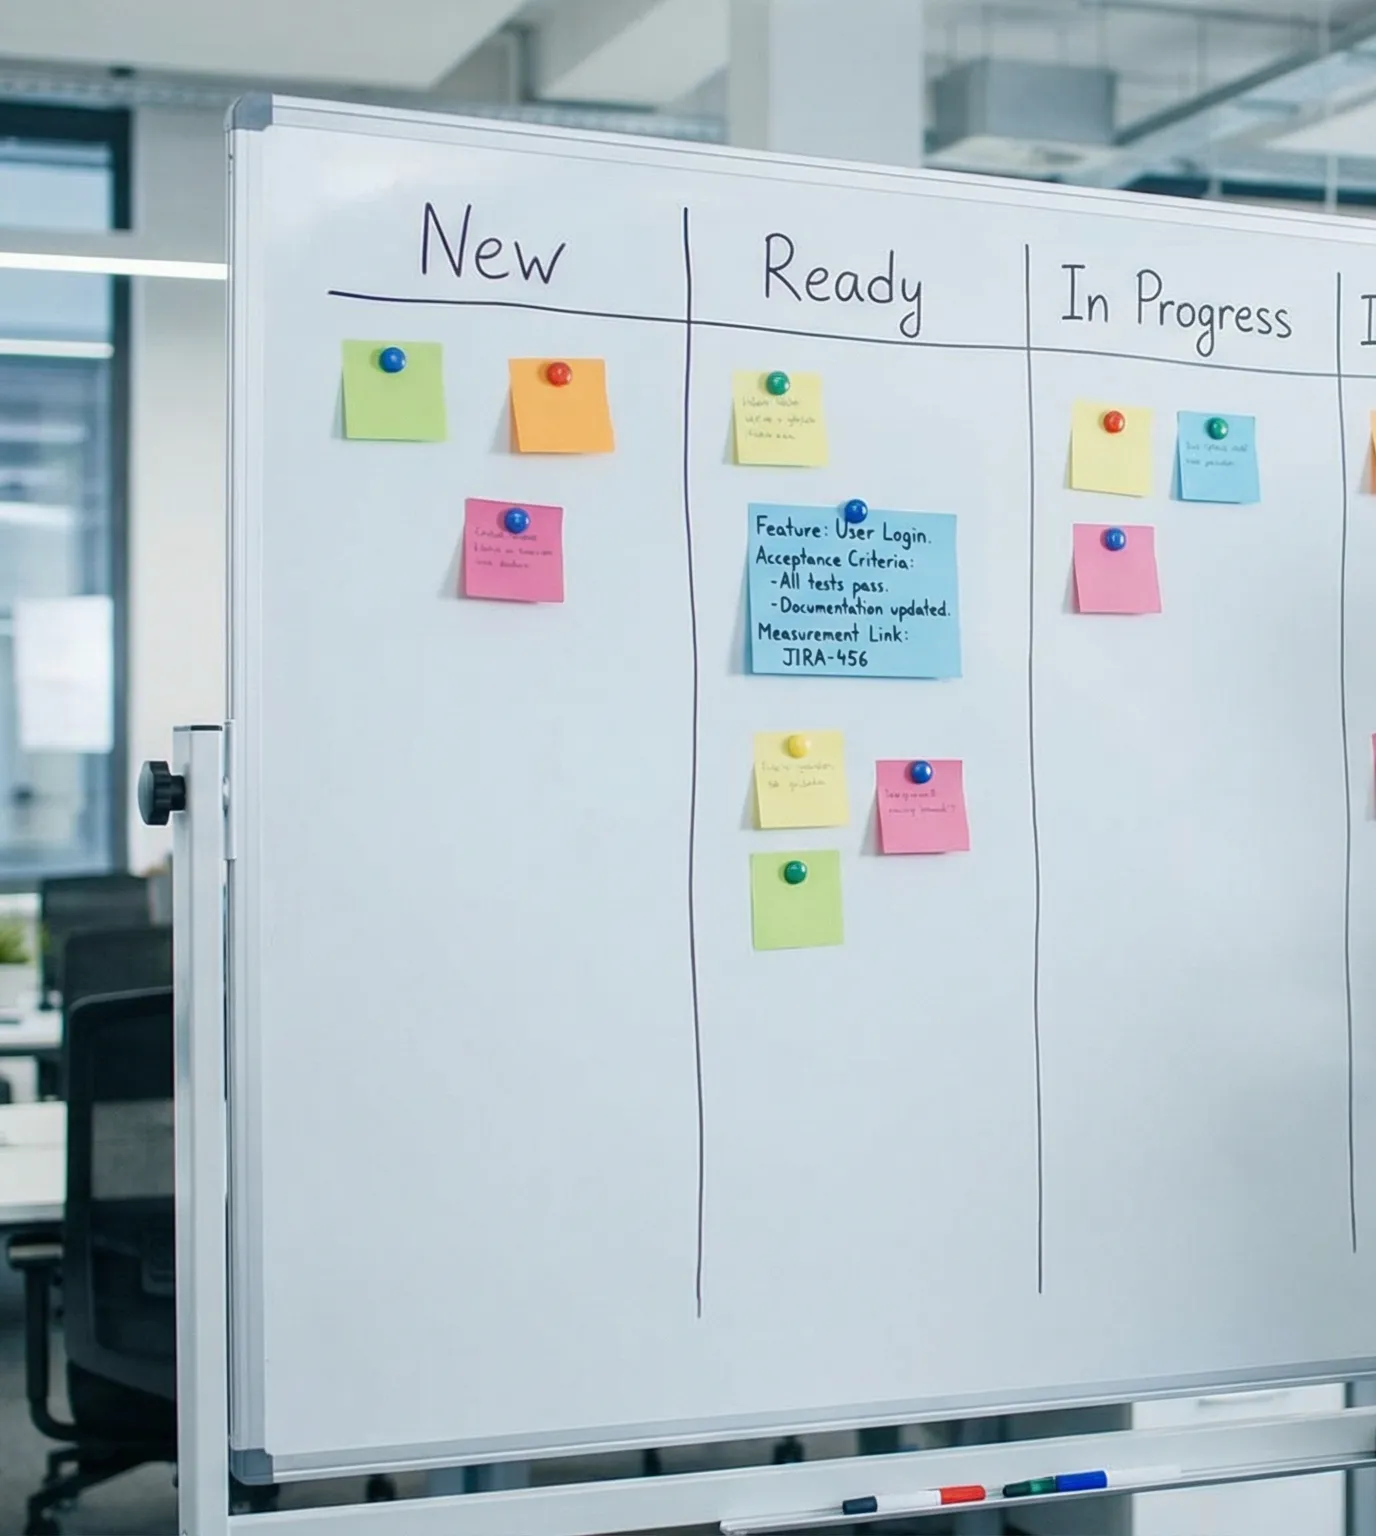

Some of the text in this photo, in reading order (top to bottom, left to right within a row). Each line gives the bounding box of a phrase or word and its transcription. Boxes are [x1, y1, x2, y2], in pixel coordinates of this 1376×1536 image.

[421, 201, 566, 285] New
[765, 232, 922, 339] Ready
[1061, 264, 1293, 358] In Progress
[756, 515, 932, 550] Feature: User Login.
[756, 545, 914, 571] Acceptance Criteria:
[808, 572, 844, 591] tests
[852, 581, 888, 600] pass.
[890, 598, 951, 622] updated.
[758, 622, 909, 643] Measurement Link:
[782, 647, 868, 667] JIRA-456
